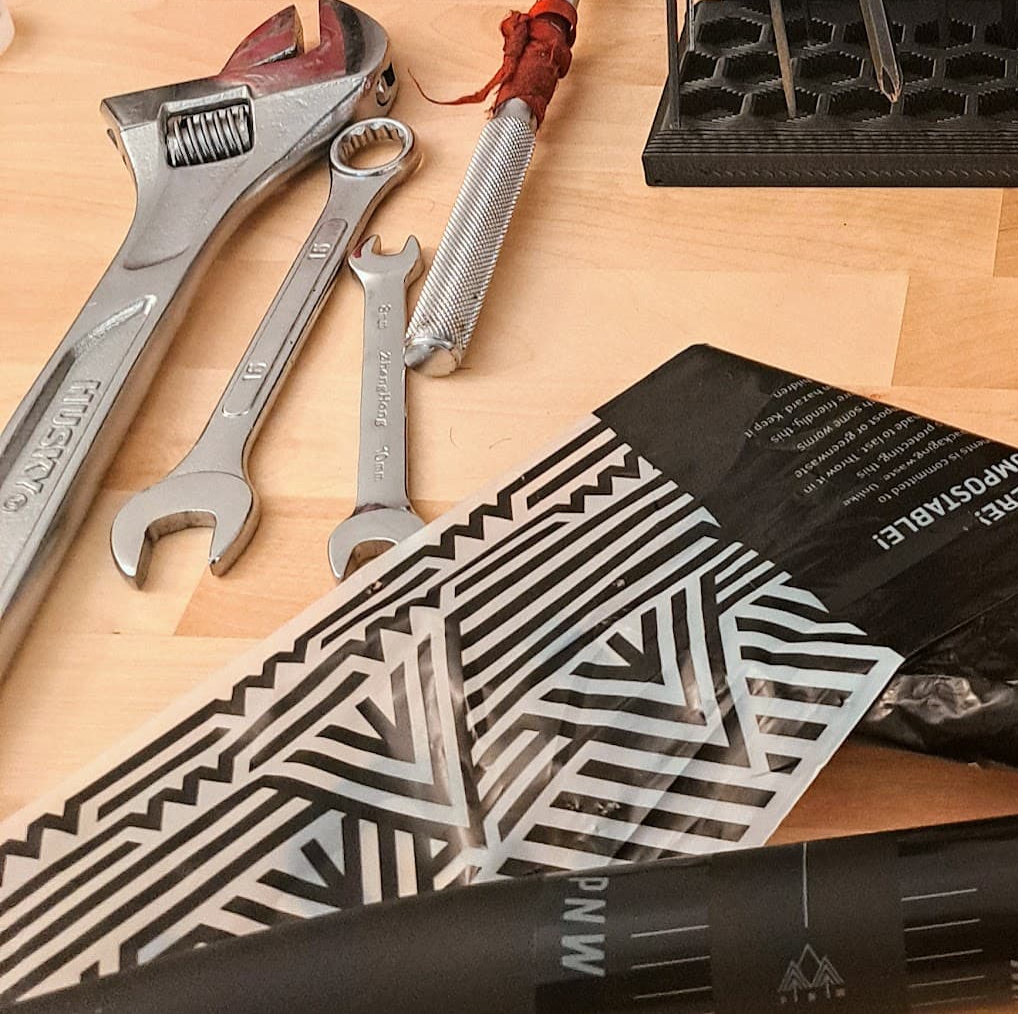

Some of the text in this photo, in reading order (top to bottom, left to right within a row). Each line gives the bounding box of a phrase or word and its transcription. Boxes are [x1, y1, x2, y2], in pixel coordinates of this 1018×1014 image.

[753, 412, 785, 432] Keep
[832, 405, 863, 427] some
[743, 429, 758, 439] it
[770, 426, 795, 443] this
[856, 423, 869, 434] or
[882, 428, 896, 439] to
[796, 425, 834, 451] worms
[794, 430, 856, 479] greenwaste
[947, 452, 962, 462] is
[826, 453, 861, 478] Throw
[856, 463, 881, 479] this
[815, 475, 829, 485] it
[891, 458, 949, 496] committed
[803, 482, 818, 494] in
[842, 482, 880, 507] Unlike
[878, 491, 893, 504] to
[561, 876, 610, 977] PNW
